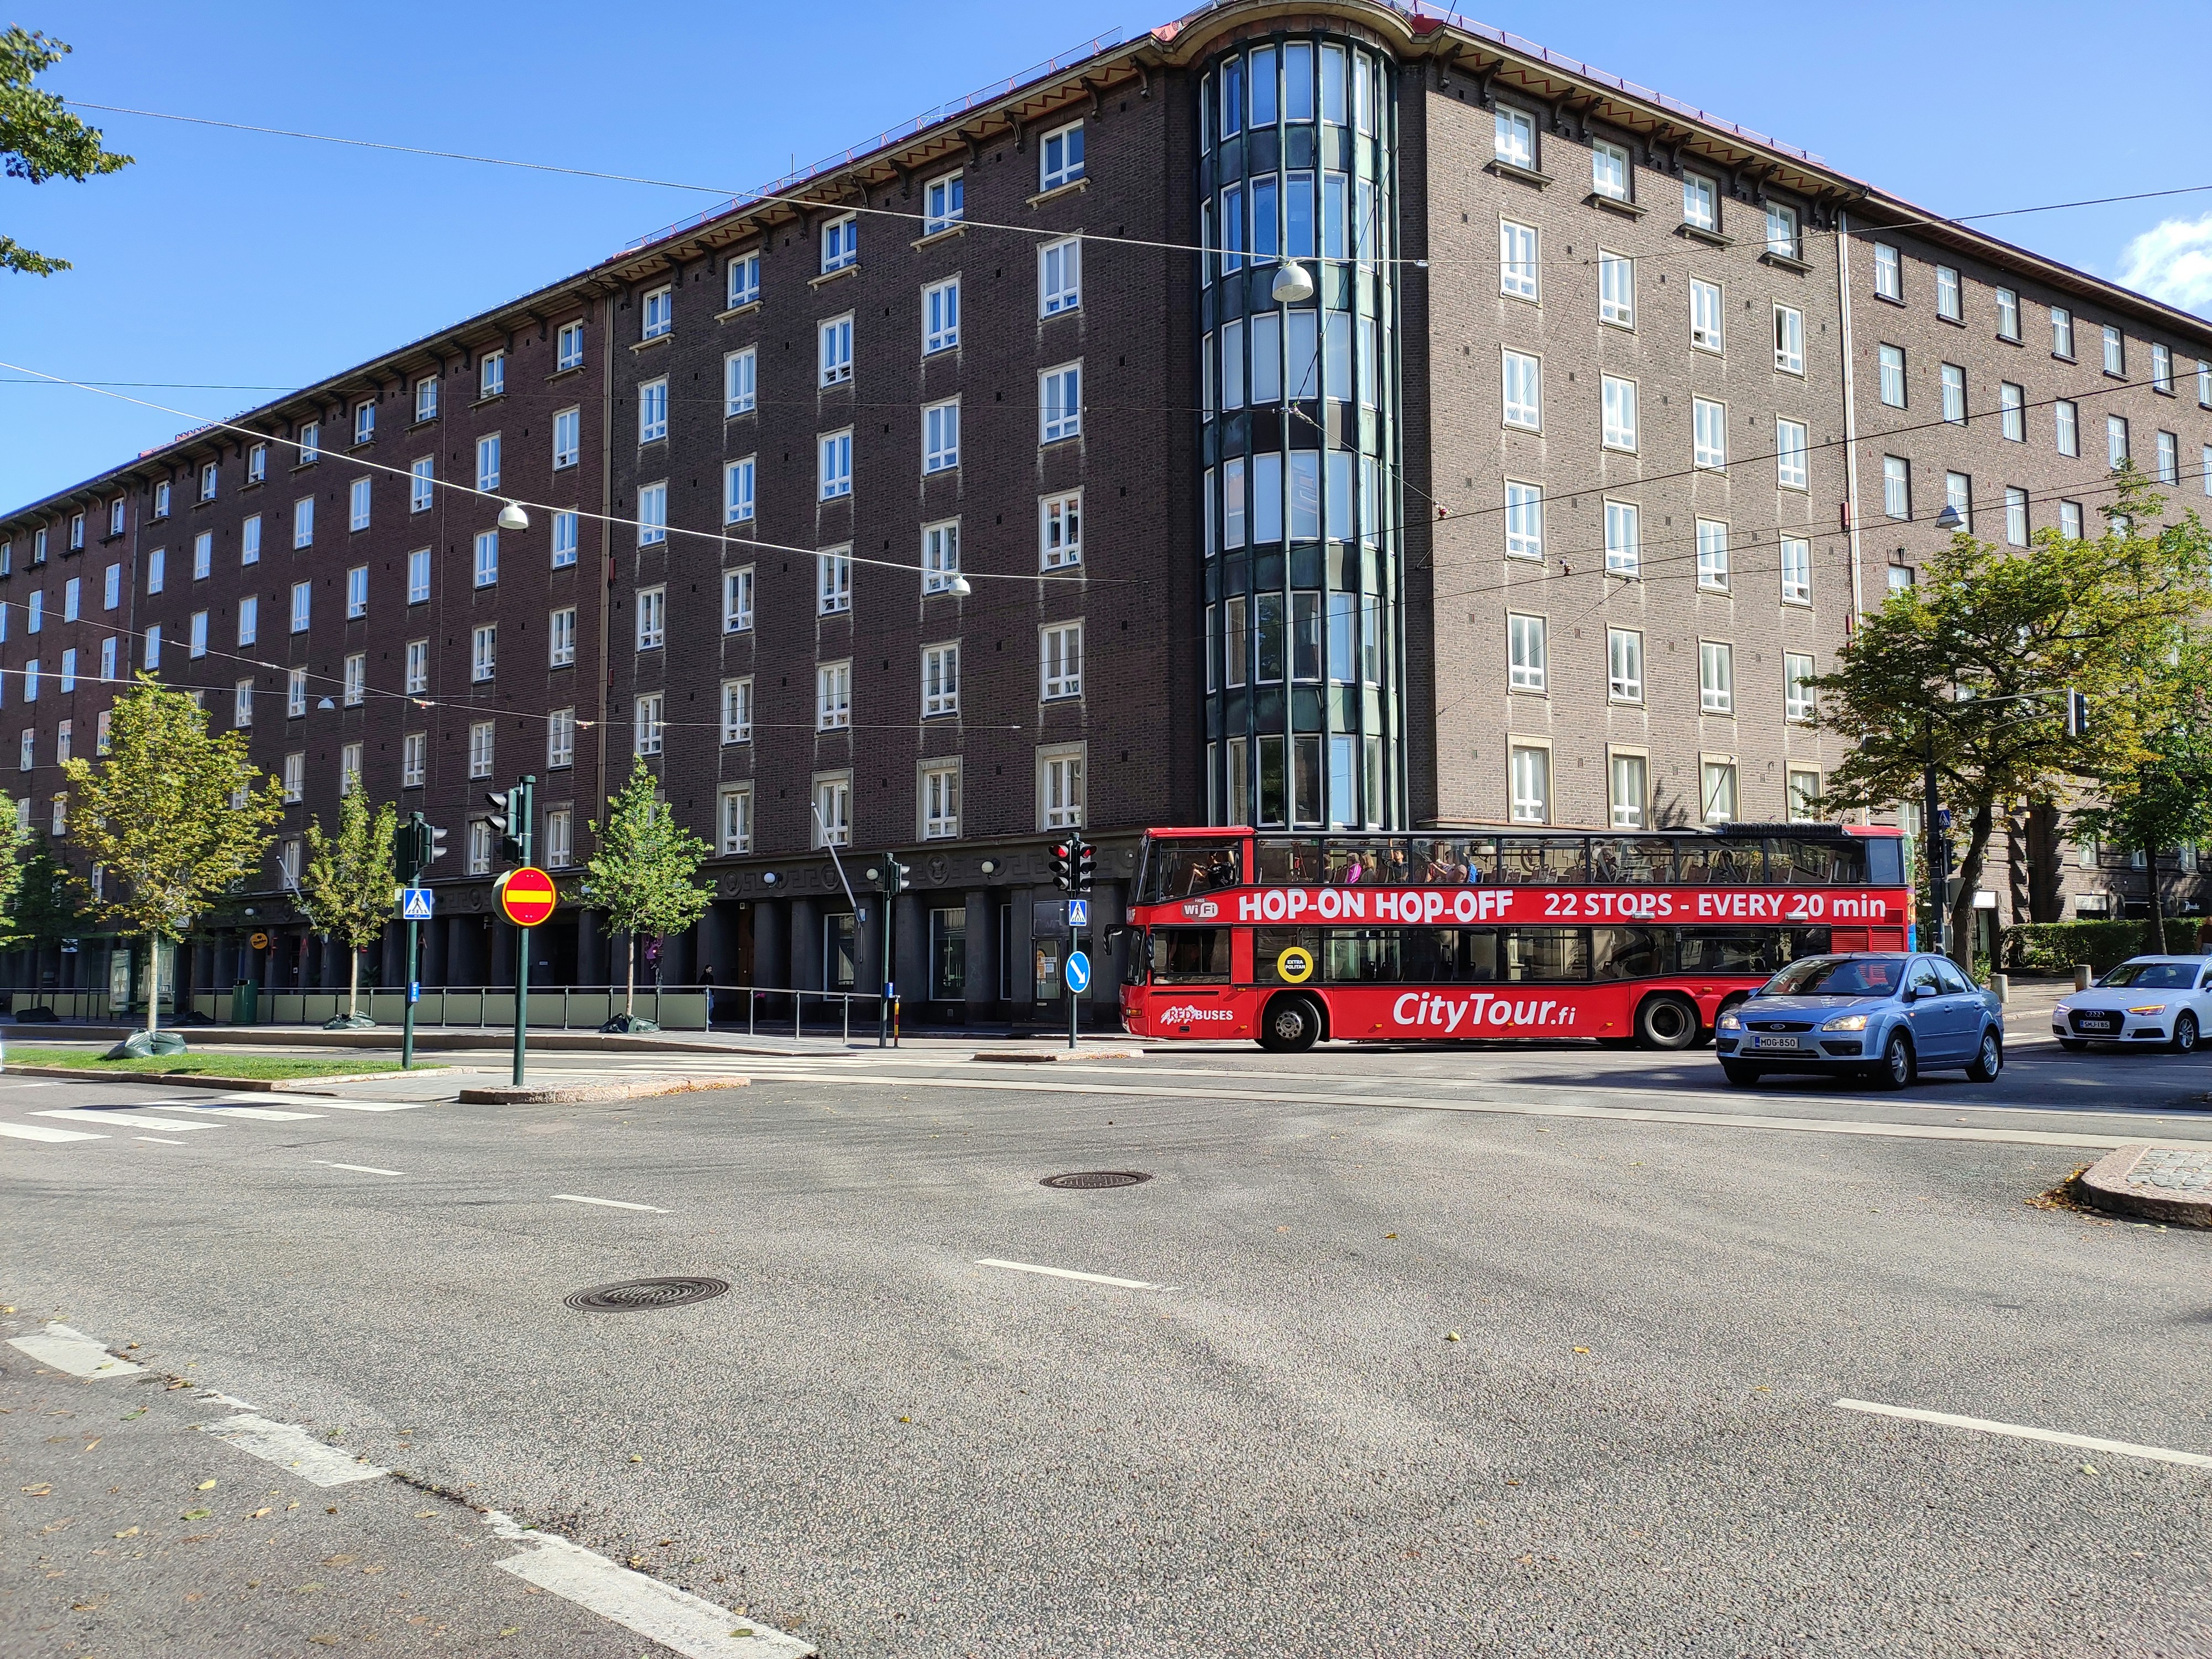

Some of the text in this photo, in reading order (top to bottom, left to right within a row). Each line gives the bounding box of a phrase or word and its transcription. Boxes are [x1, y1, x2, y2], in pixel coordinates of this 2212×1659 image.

[1239, 888, 1514, 922] HOP-ON HOP-OFF
[1545, 893, 1578, 916] 22
[1584, 893, 1673, 916] STOPS
[1698, 894, 1785, 916] EVERY
[1792, 894, 1825, 917] 20
[1833, 894, 1886, 917] min
[1195, 1010, 1234, 1020] BUSES
[1393, 992, 1576, 1032] CityTour.fi
[1760, 1039, 1796, 1047] MOG-850
